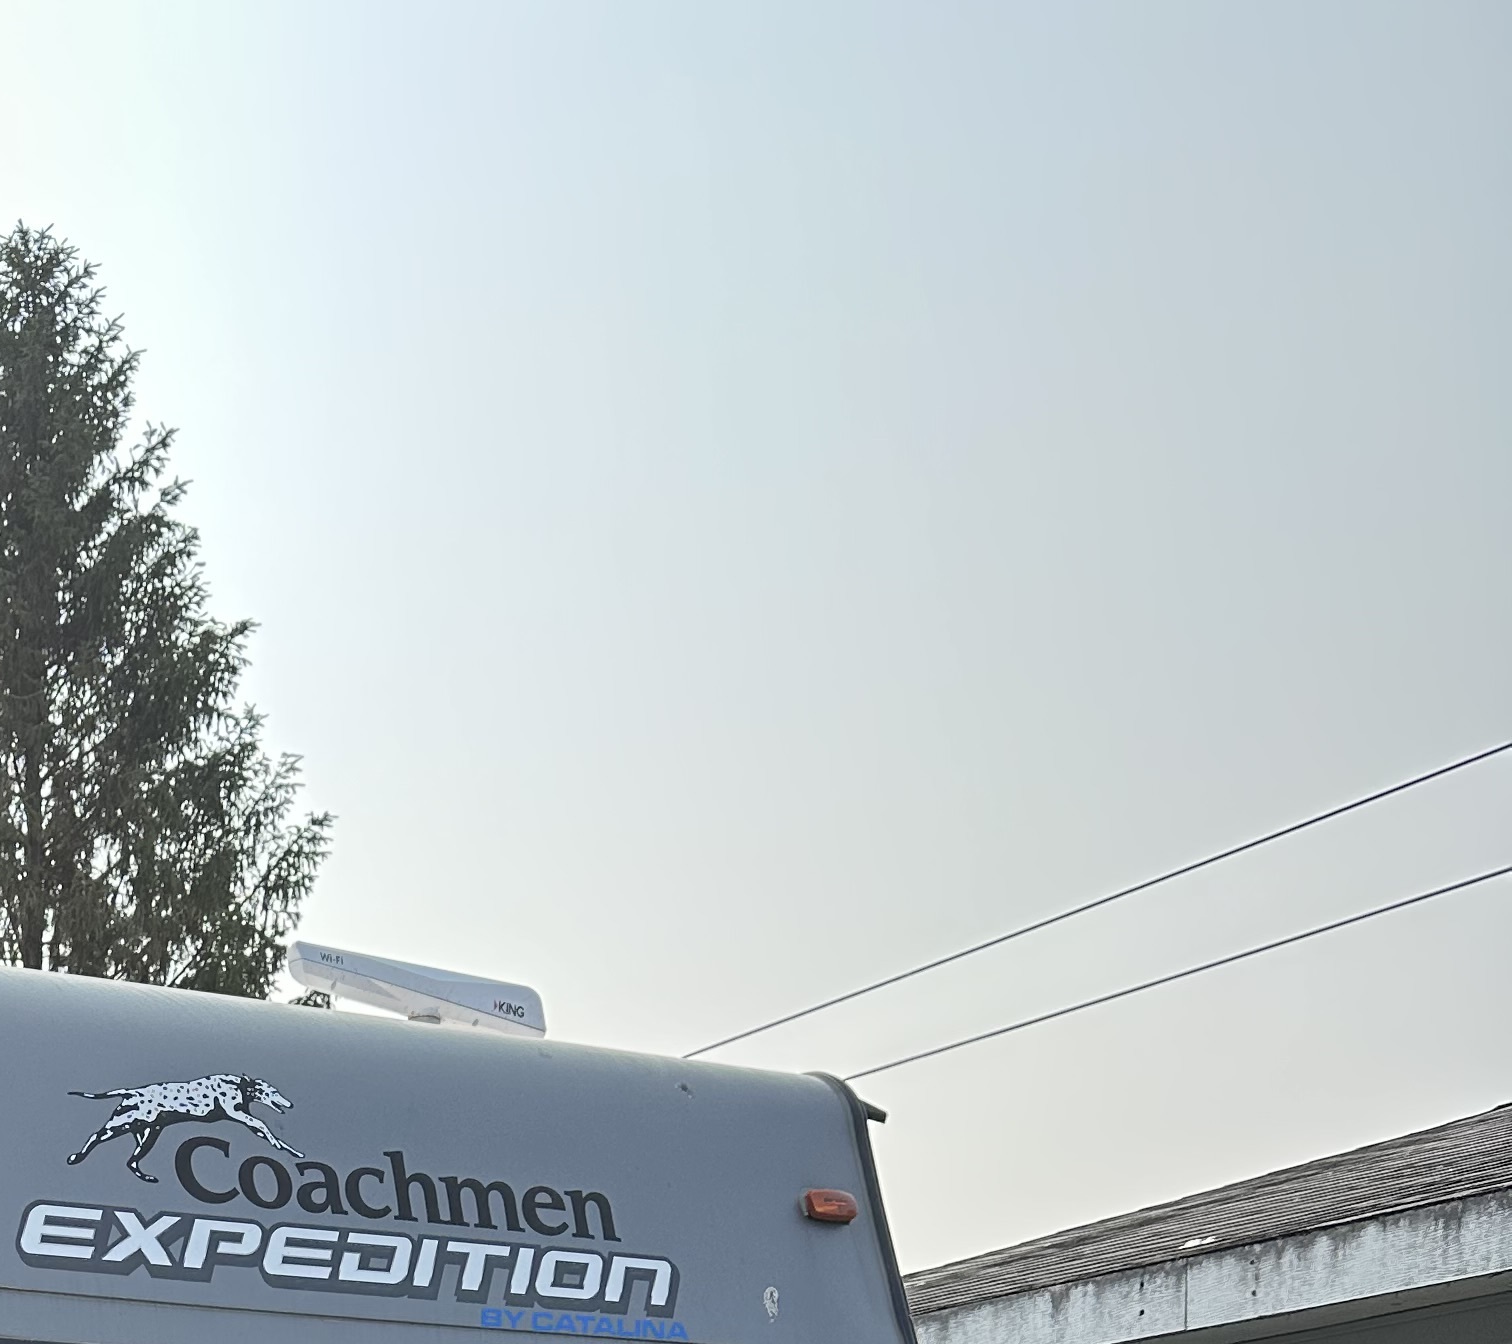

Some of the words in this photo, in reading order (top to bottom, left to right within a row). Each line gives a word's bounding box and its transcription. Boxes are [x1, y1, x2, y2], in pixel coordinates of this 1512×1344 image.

[498, 1000, 525, 1018] KING
[174, 1135, 621, 1243] Coachmen
[17, 1202, 678, 1314] EXPEDITION
[480, 1307, 525, 1329] BY
[531, 1311, 688, 1340] CATALINA
